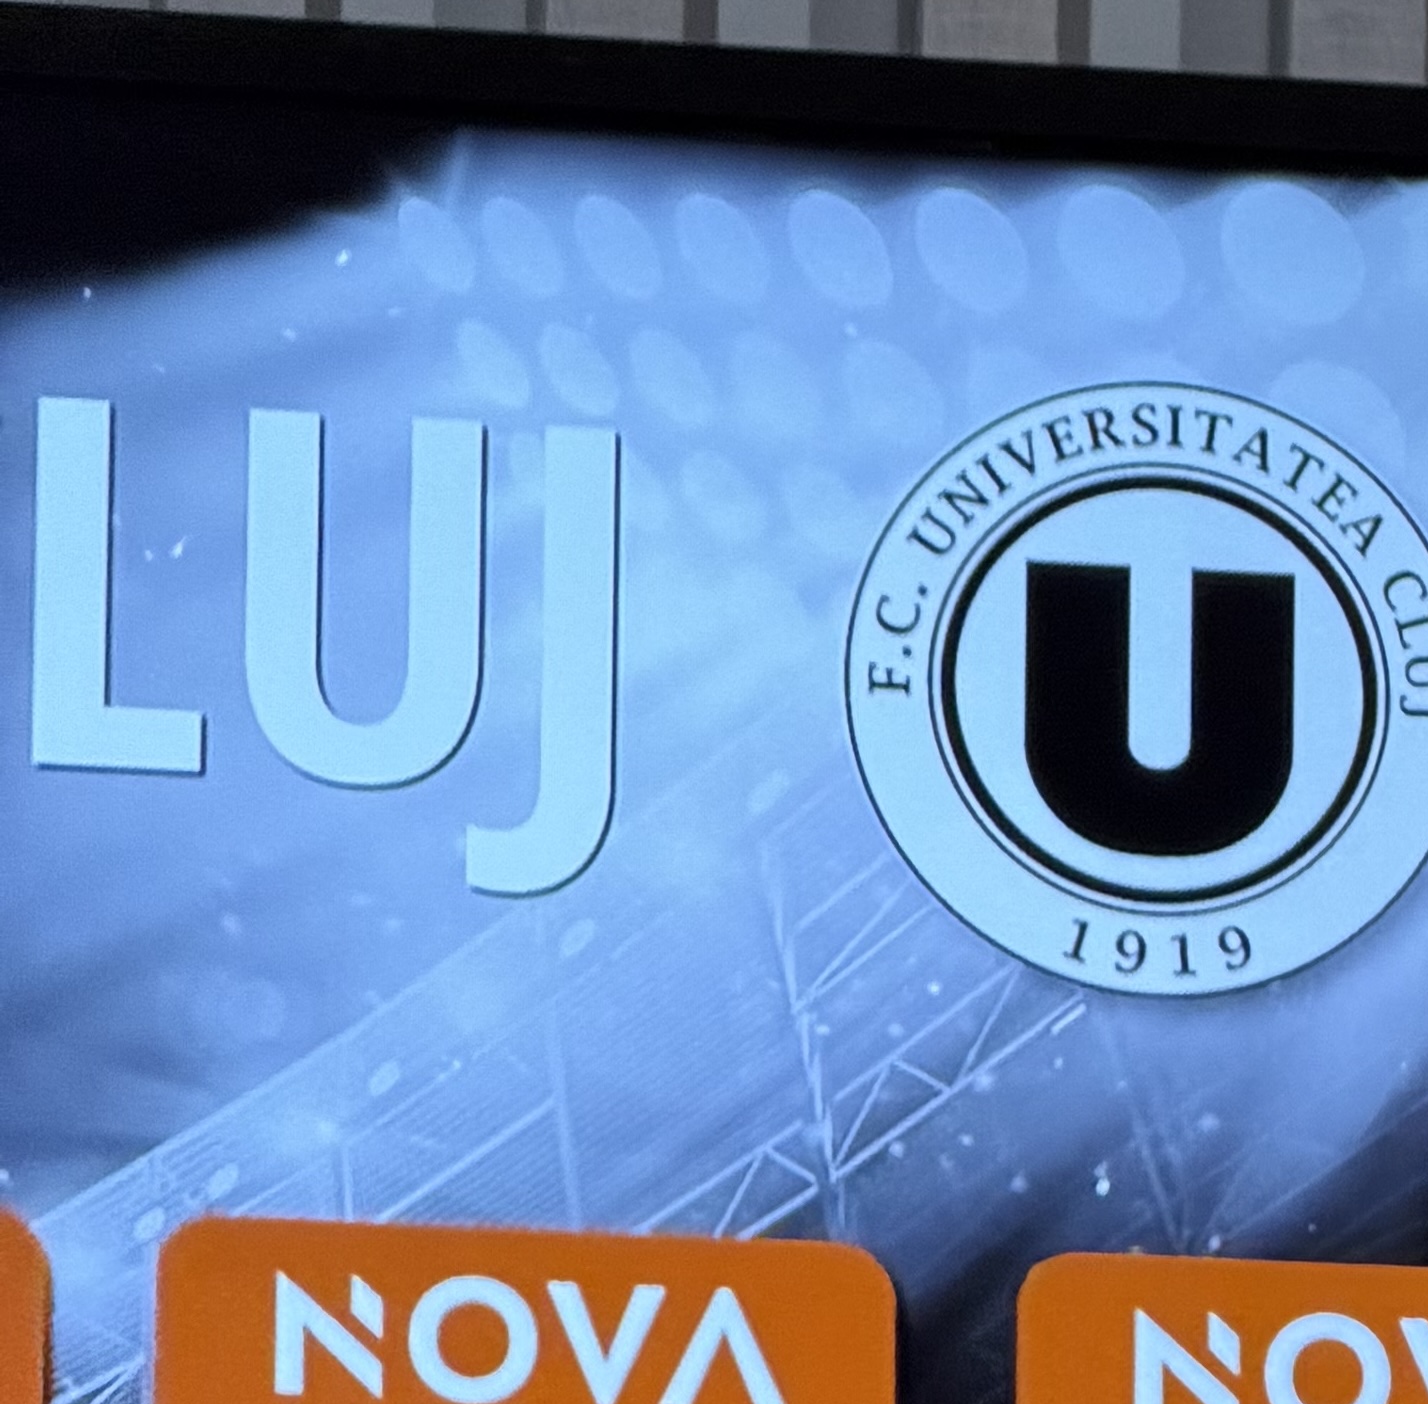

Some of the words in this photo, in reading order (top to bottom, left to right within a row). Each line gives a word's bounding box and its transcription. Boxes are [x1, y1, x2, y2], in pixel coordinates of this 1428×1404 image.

[868, 581, 929, 698] F.C.
[906, 402, 1385, 559] UNIVERSITATEA
[1023, 559, 1297, 858] U
[1062, 917, 1254, 979] 1919
